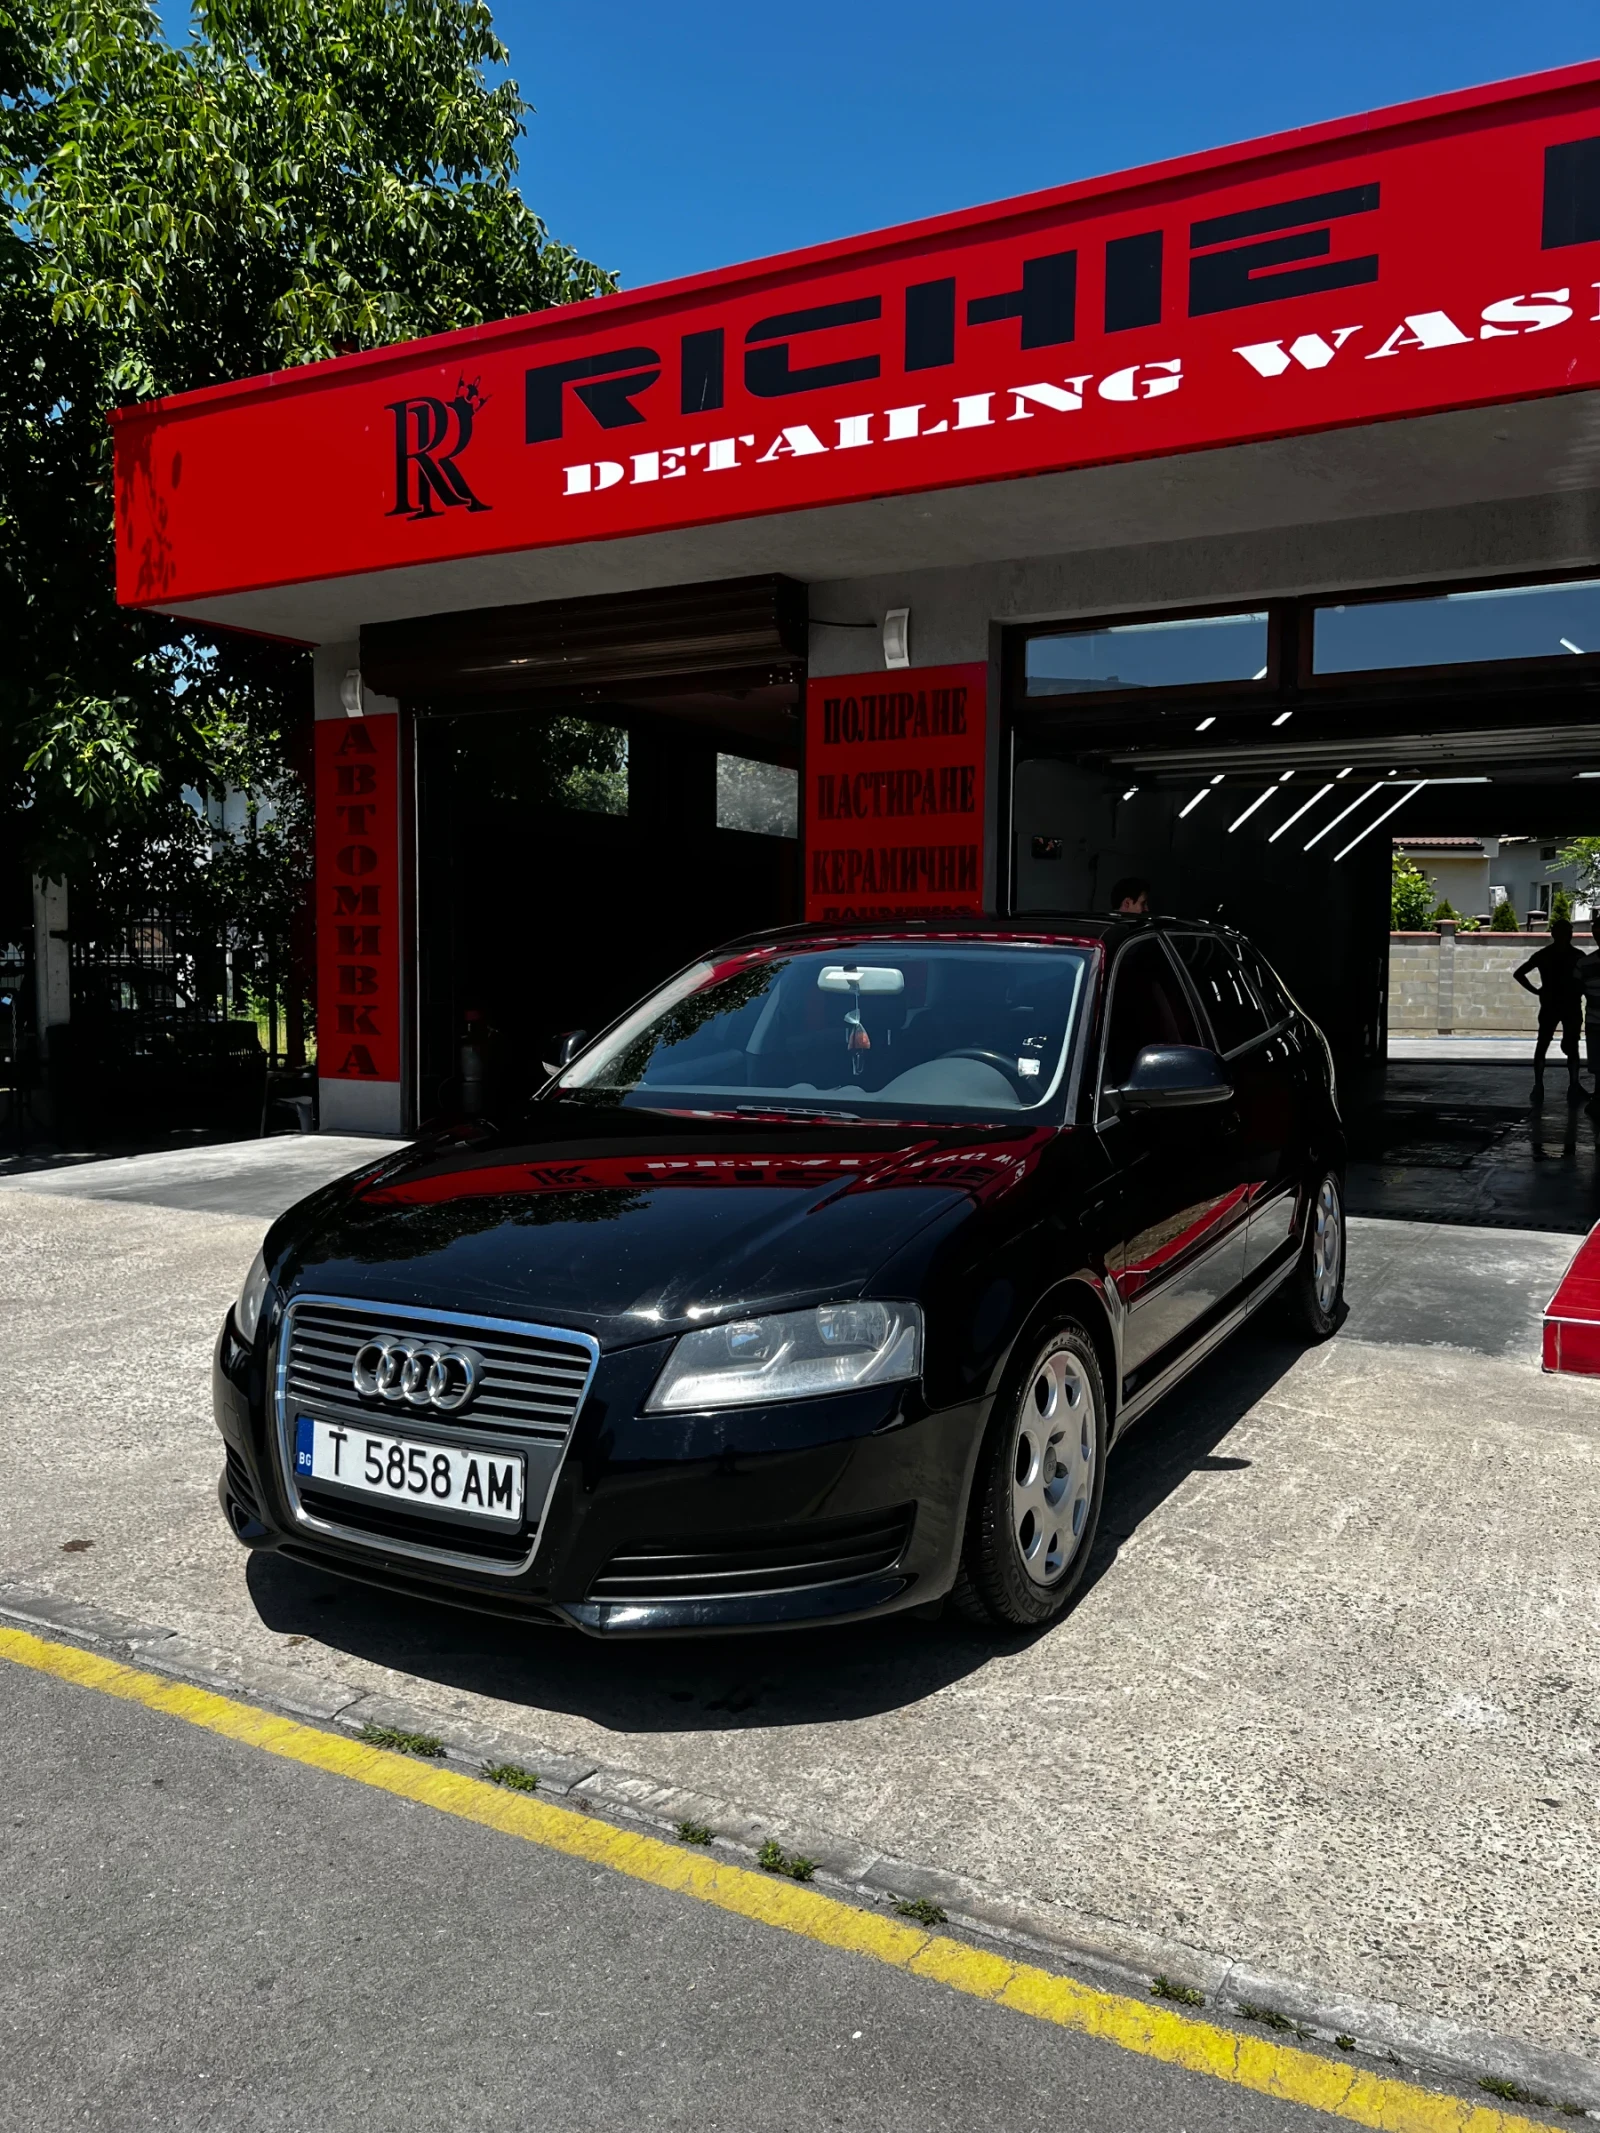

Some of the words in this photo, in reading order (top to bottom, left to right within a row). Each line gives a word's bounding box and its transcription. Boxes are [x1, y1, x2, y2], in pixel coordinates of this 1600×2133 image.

[525, 182, 1380, 444] RICHIE
[562, 359, 1183, 495] DETAILING
[1232, 282, 1600, 377] WAS
[824, 687, 967, 744] ПОЛИРАНЕ
[817, 766, 975, 820] ПАСТИРАНЕ
[332, 723, 382, 1075] АВТОМИВКА
[812, 844, 978, 895] КЕРАМИЧНИ
[299, 1452, 312, 1466] BG
[329, 1430, 348, 1476] T
[365, 1439, 452, 1498] 5858
[461, 1459, 513, 1511] AM
